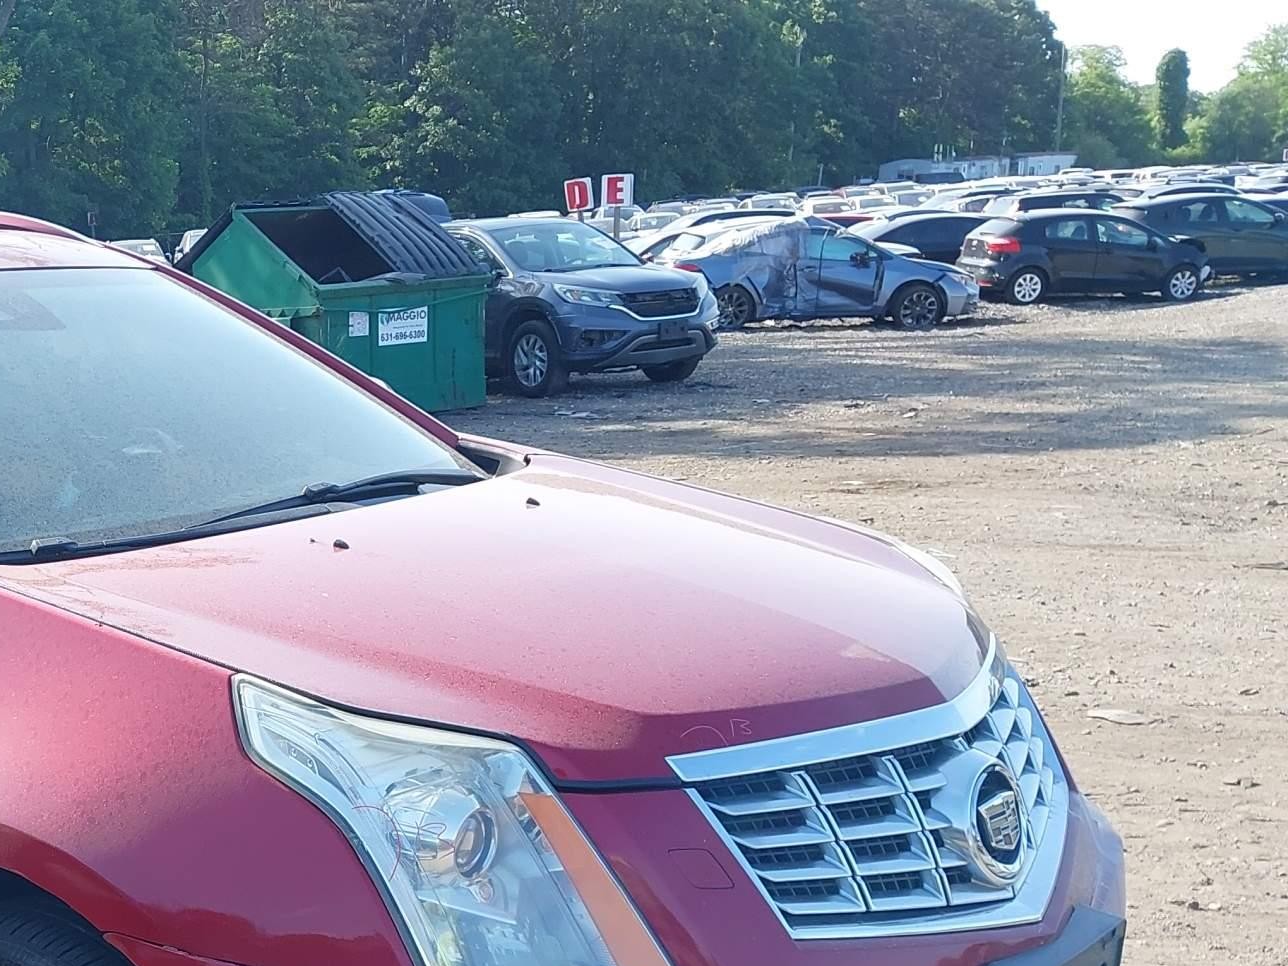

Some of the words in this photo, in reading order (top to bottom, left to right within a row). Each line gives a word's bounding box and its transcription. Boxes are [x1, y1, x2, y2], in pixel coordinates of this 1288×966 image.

[567, 181, 589, 209] D
[607, 176, 625, 204] E
[387, 310, 426, 322] MAGGIO
